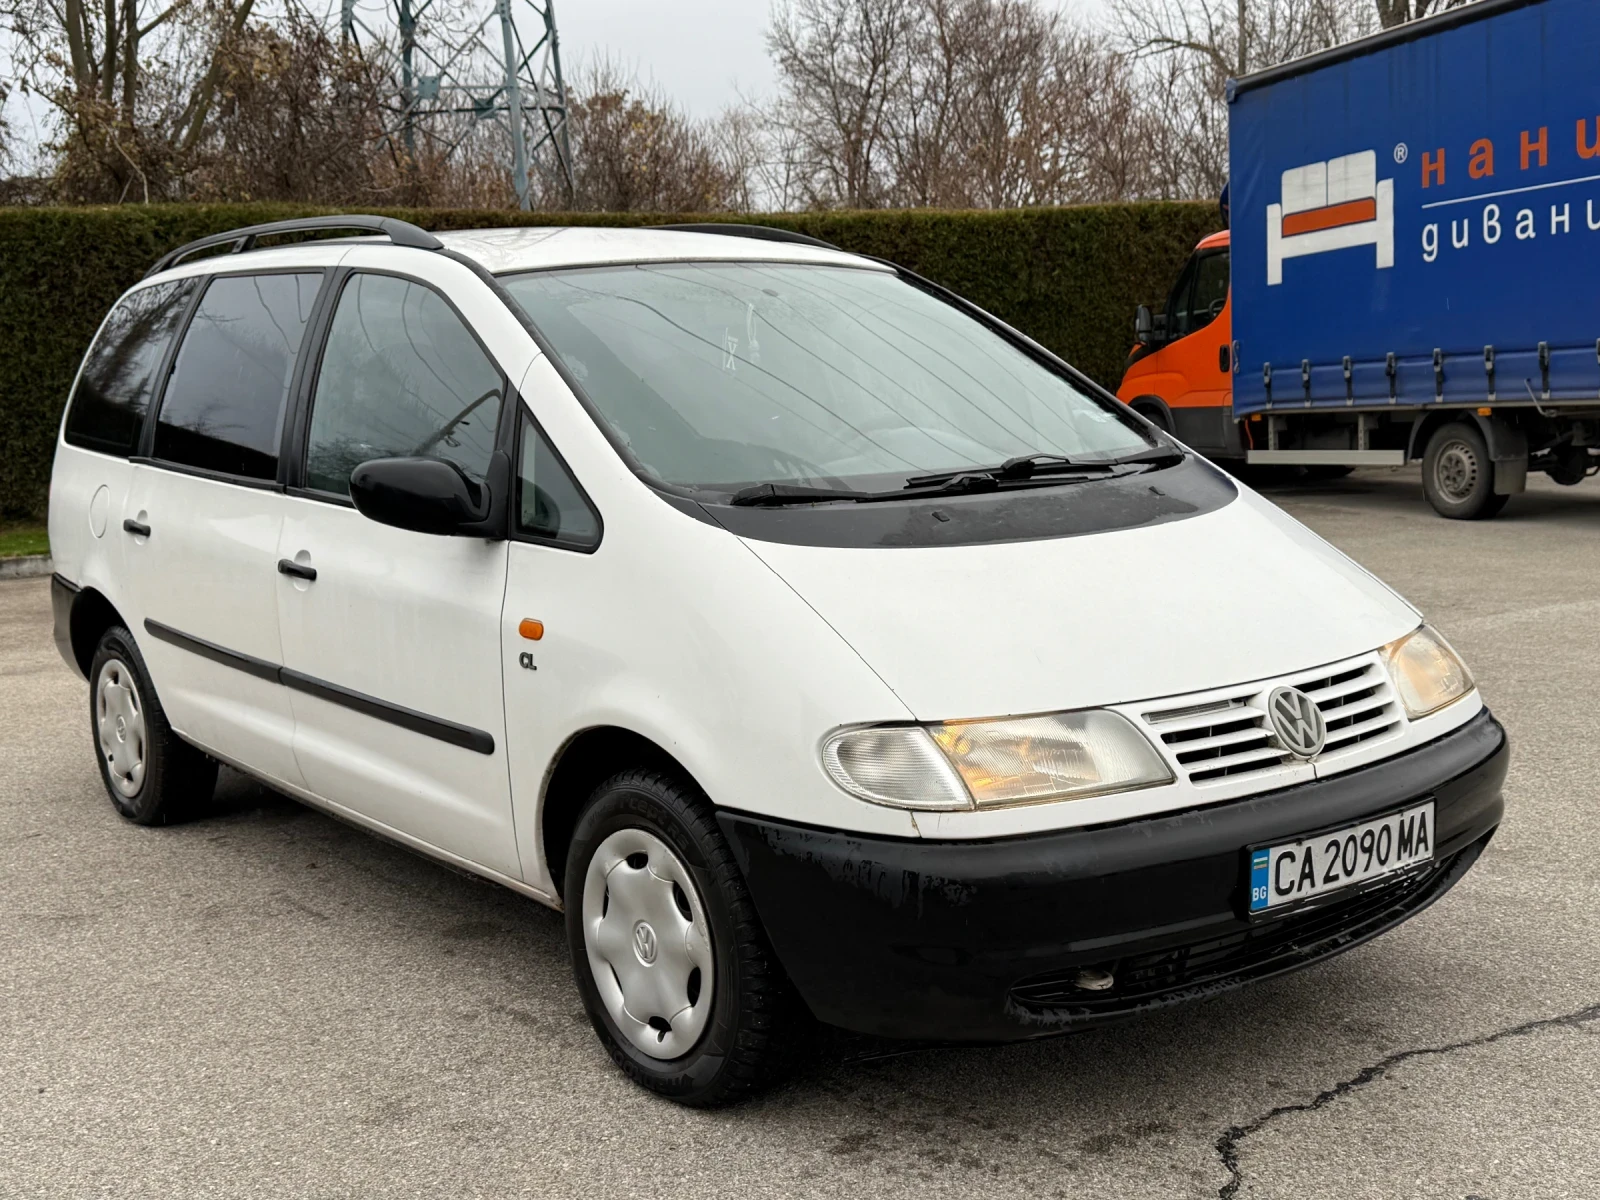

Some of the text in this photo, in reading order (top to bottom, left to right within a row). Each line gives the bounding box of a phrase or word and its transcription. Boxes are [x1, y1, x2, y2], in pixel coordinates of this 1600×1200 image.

[519, 651, 538, 671] CL
[1274, 811, 1429, 896] CA 2090 MA
[1252, 886, 1267, 901] BG
